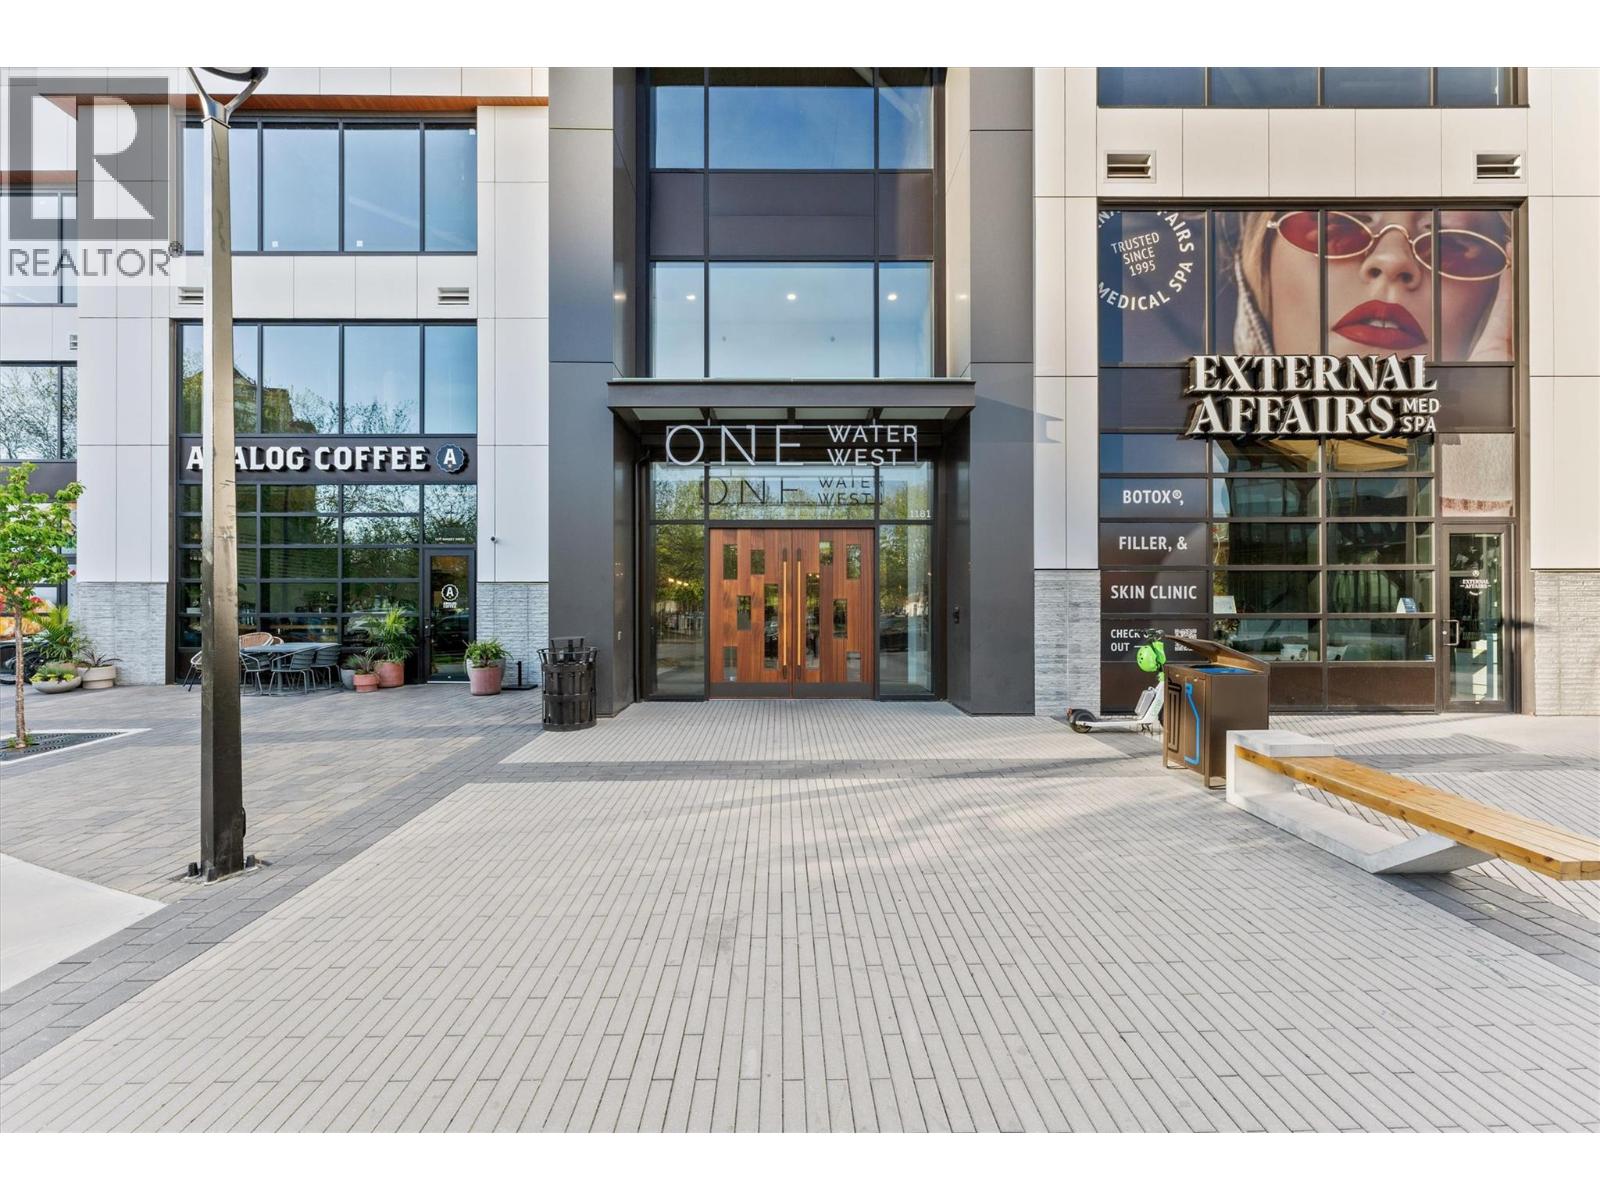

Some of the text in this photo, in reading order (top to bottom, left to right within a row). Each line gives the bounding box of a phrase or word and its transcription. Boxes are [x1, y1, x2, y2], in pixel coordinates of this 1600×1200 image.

[1110, 232, 1160, 254] TRUSTED
[1122, 246, 1156, 265] SINCE
[1128, 259, 1156, 277] 1995
[1098, 261, 1194, 311] MEDICAL SPA
[1192, 353, 1438, 392] EXTERNAL
[1402, 397, 1440, 414] MED
[1191, 395, 1395, 435] AFFAIRS
[827, 424, 918, 443] WATER
[1401, 416, 1437, 433] SPA
[665, 424, 803, 466] ONE
[185, 446, 457, 470] AALOG COFFEE A
[827, 448, 902, 466] WEST
[1119, 536, 1188, 552] FILLER, &
[1110, 585, 1198, 600] SKIN CLINIC
[1110, 628, 1140, 639] CHECK
[1110, 642, 1131, 652] OUT
